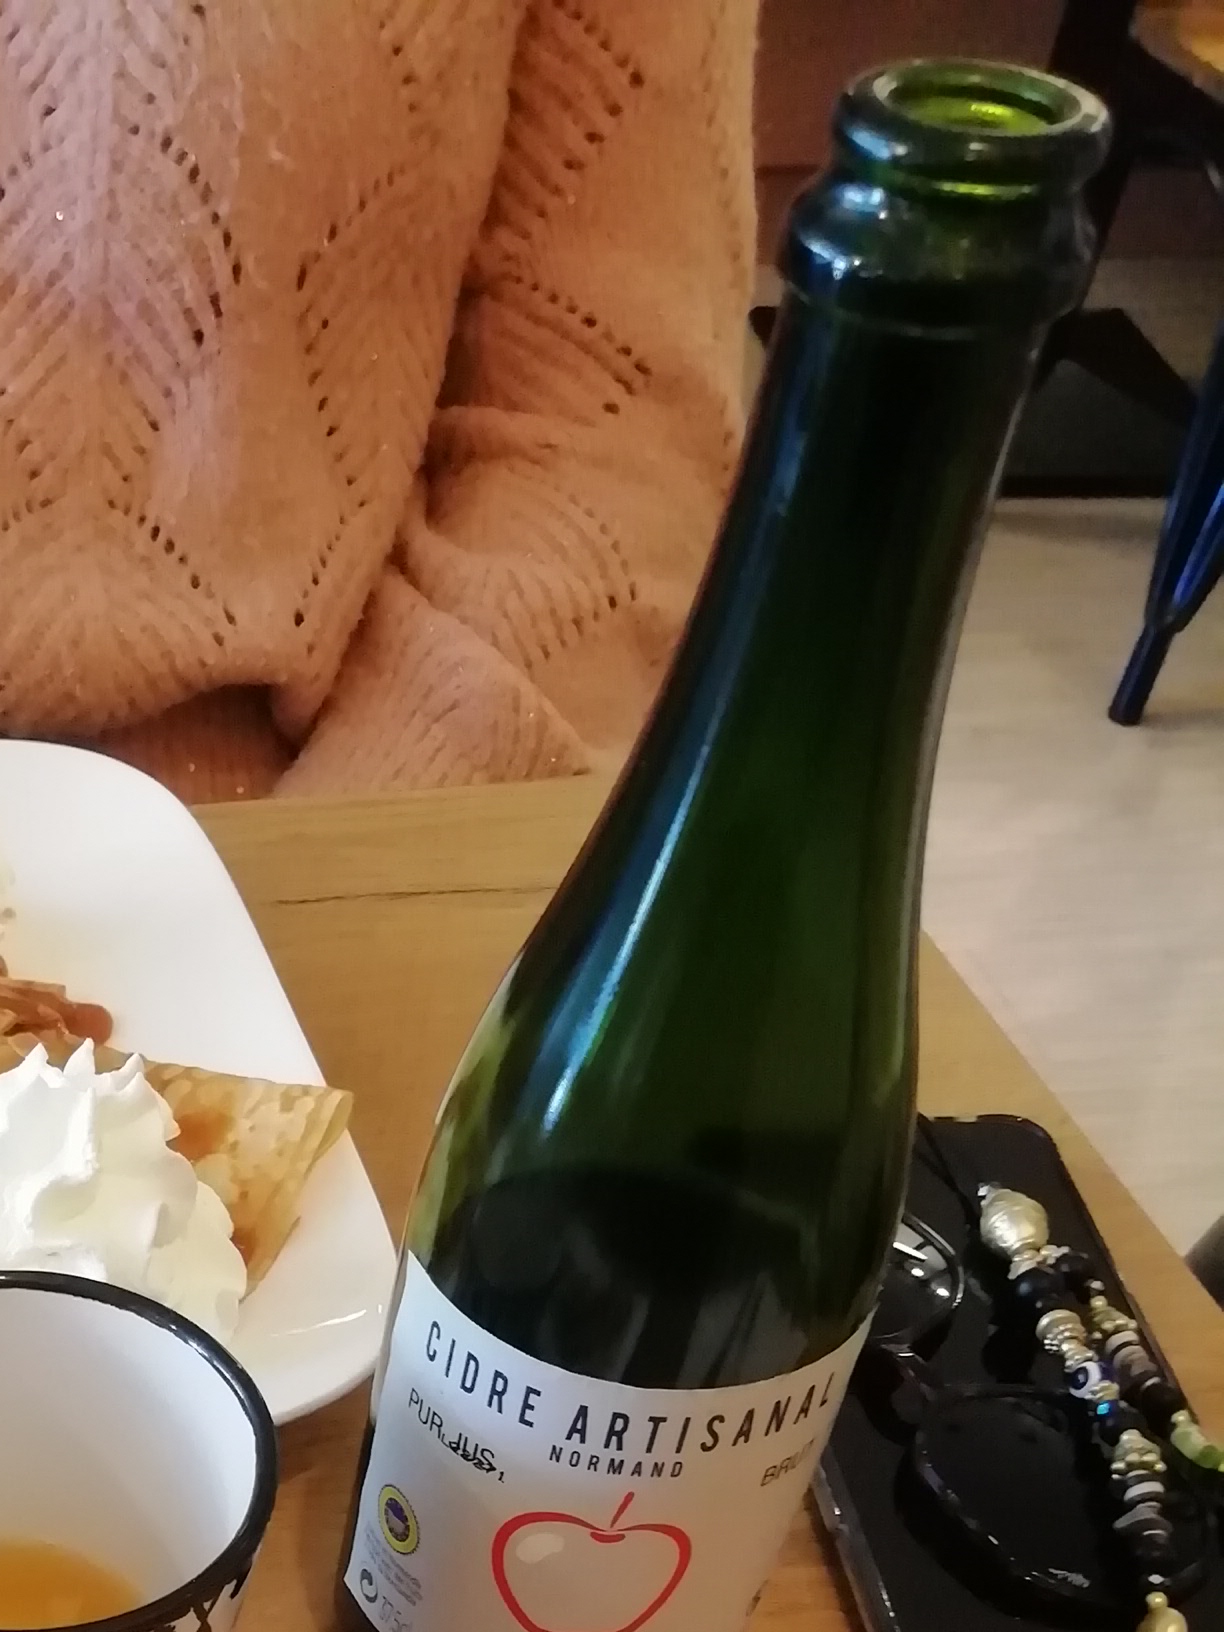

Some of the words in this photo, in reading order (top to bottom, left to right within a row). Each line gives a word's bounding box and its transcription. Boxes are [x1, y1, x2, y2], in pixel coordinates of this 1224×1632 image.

[408, 1387, 443, 1439] PUR
[426, 1320, 542, 1428] CIDRE
[565, 1371, 835, 1454] ARTISANAL
[549, 1444, 683, 1478] NORMAND
